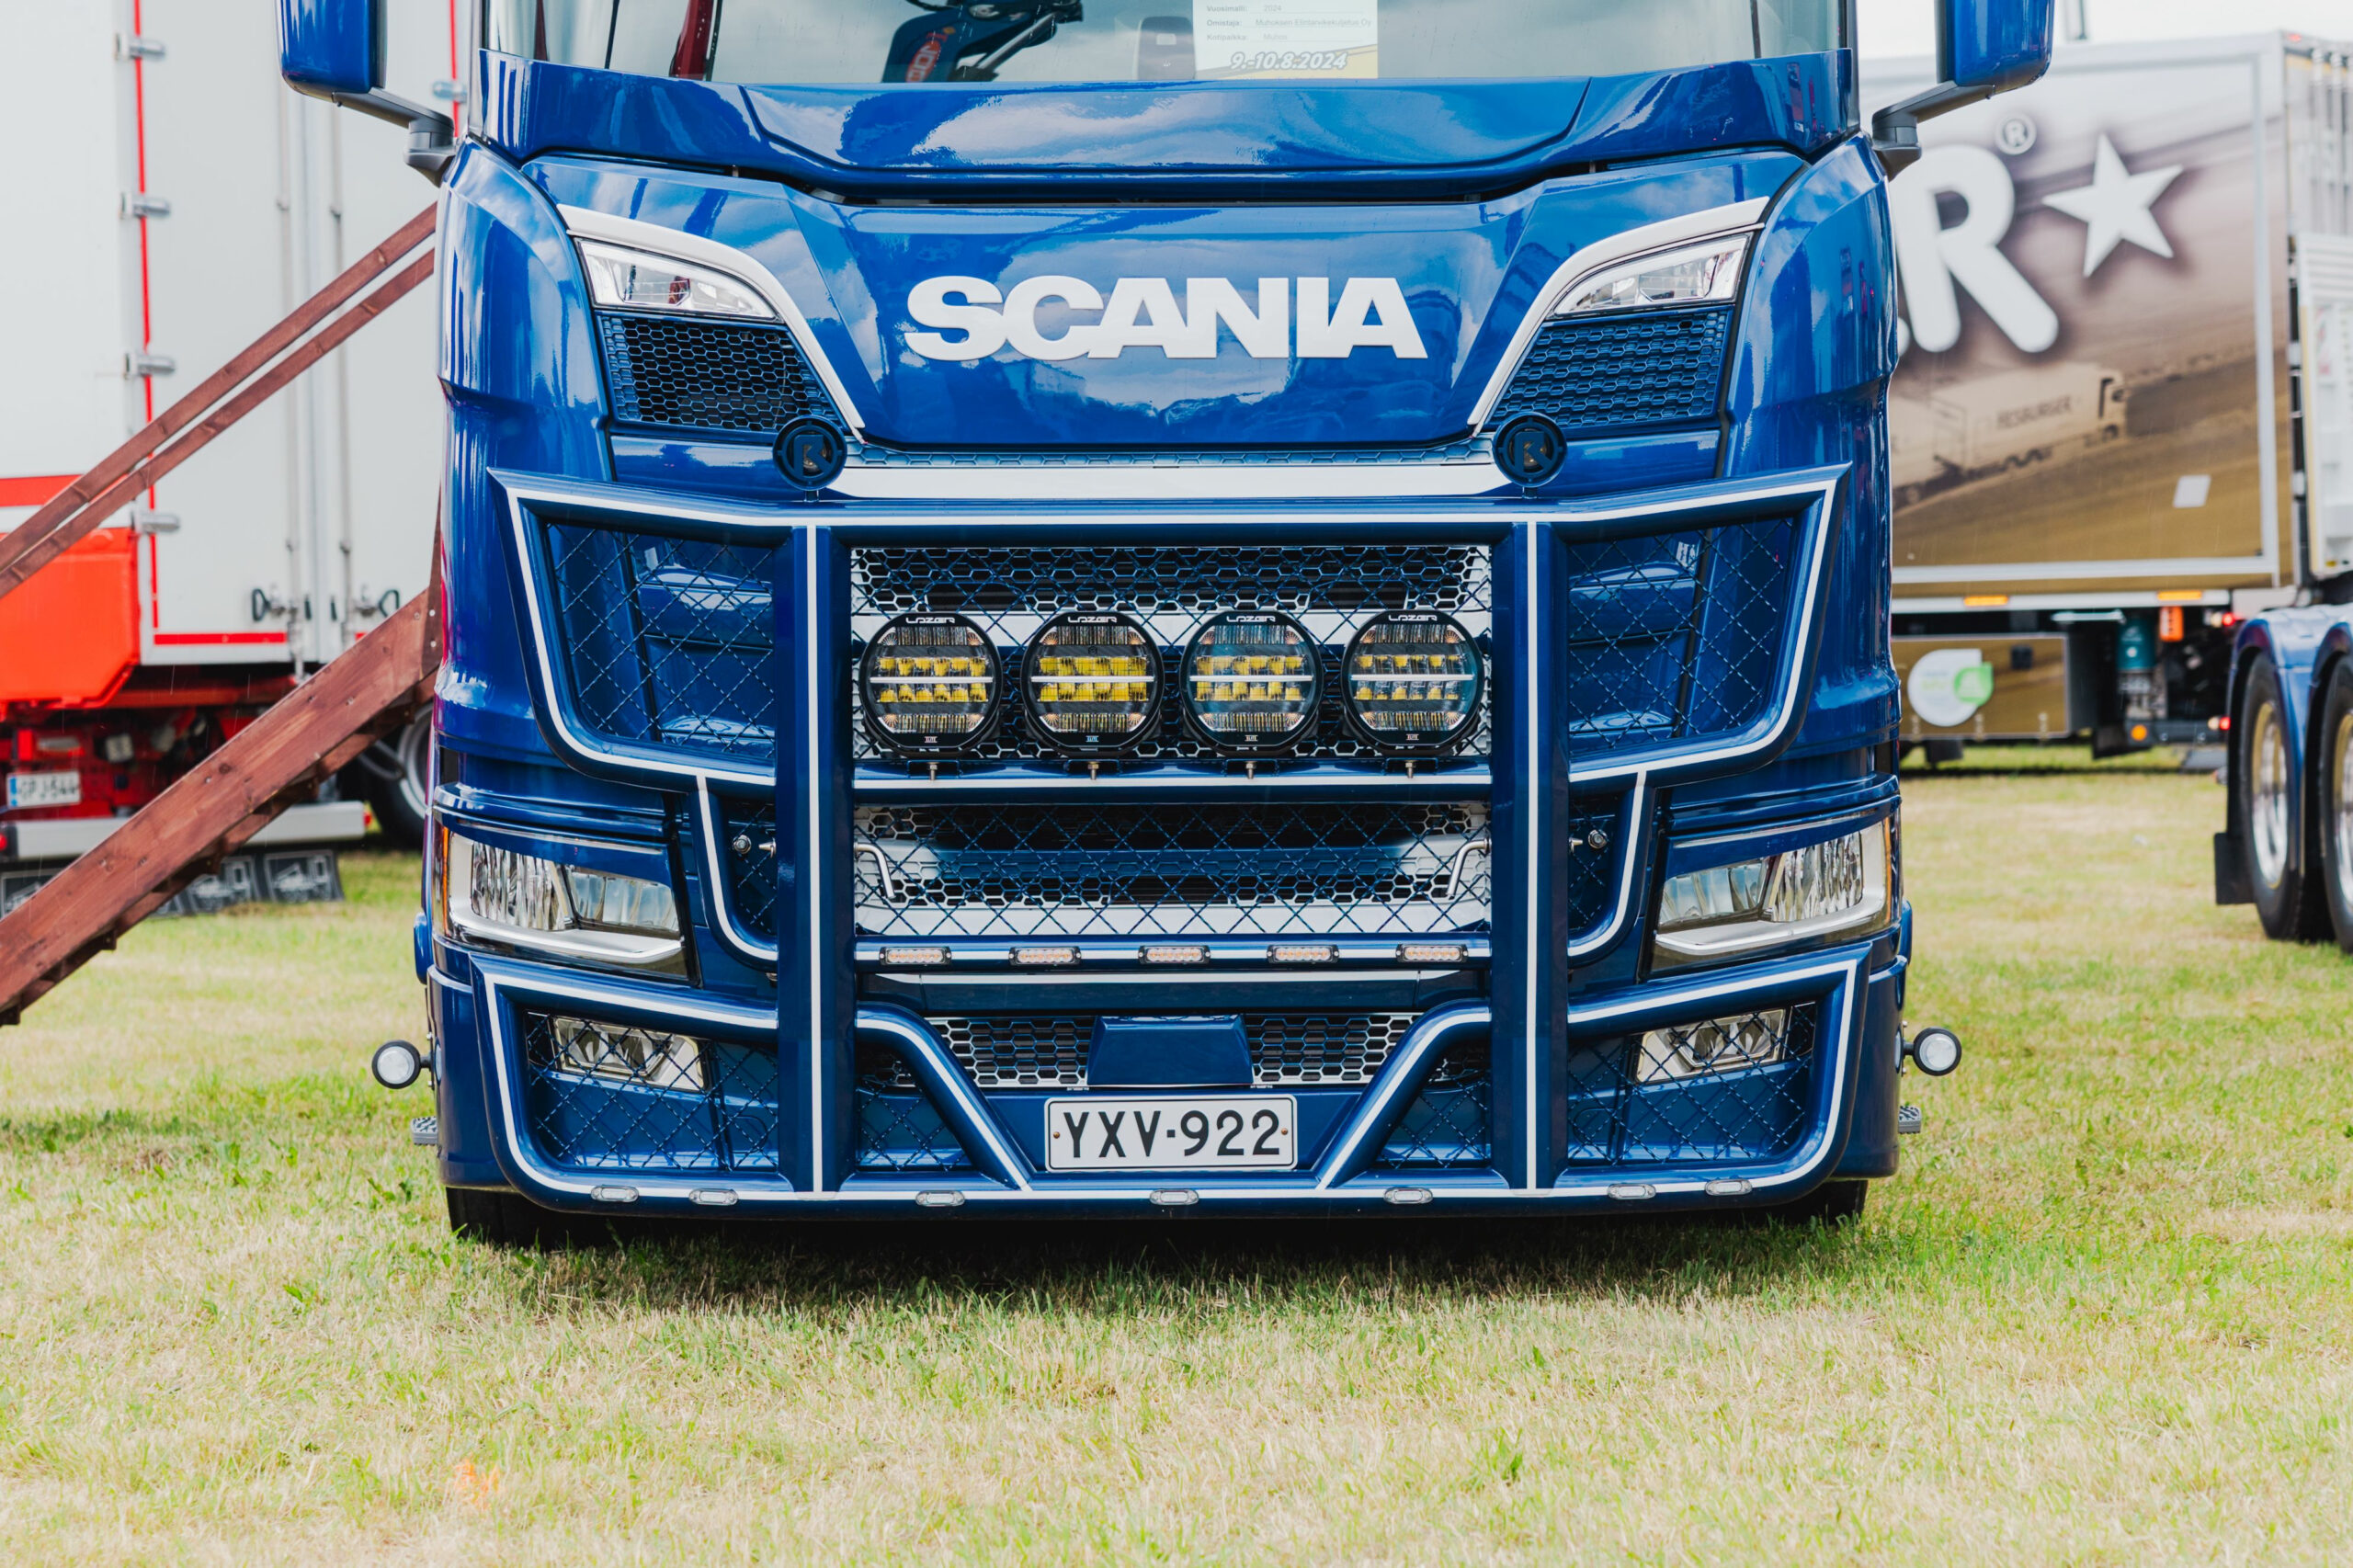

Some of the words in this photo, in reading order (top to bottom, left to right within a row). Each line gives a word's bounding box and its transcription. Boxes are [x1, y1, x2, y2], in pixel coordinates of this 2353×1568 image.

[1206, 19, 1243, 28] Omistaja:
[1230, 51, 1348, 71] 9.-10.8.2024
[904, 275, 1428, 361] SCANIA
[1063, 1108, 1280, 1158] YXV-922
